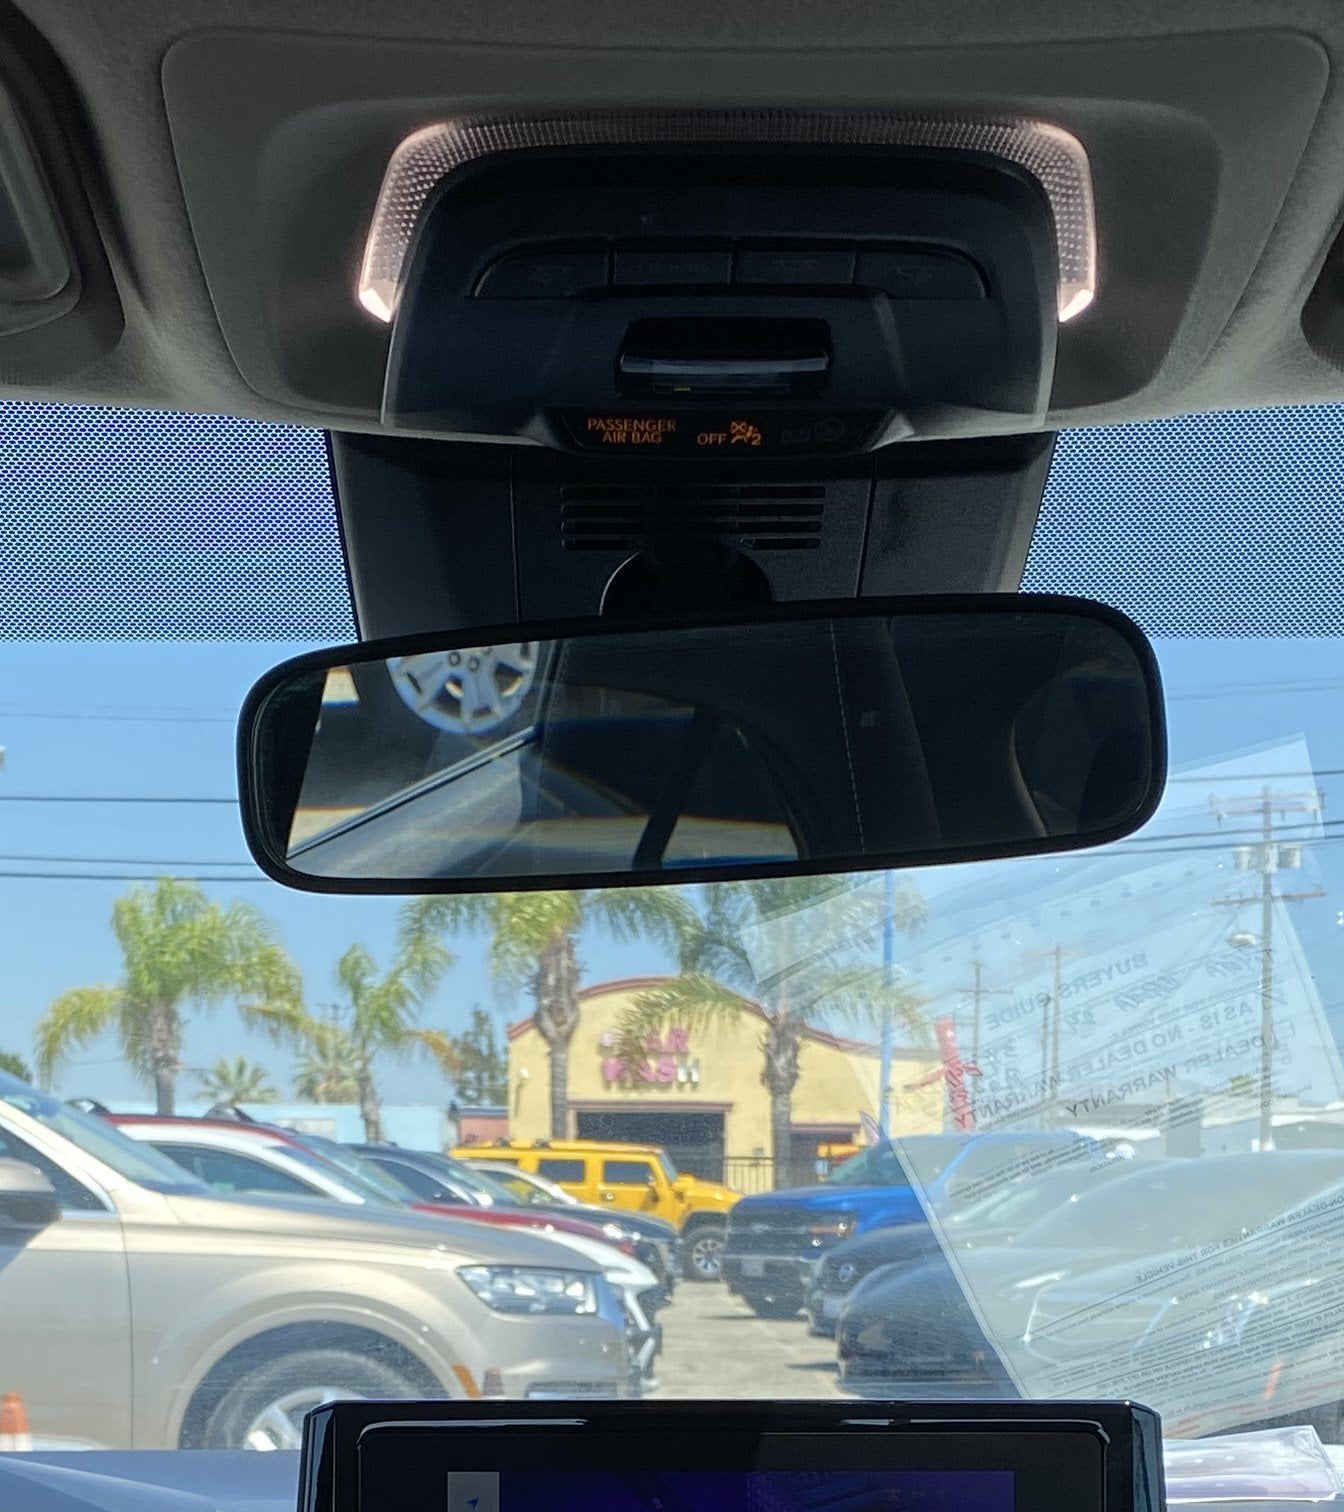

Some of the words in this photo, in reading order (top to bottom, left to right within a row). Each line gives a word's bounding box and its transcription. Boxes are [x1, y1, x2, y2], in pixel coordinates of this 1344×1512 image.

[587, 418, 676, 431] PASSENGER
[602, 431, 626, 443] AIR
[632, 432, 662, 444] BAG
[697, 433, 727, 445] OFF
